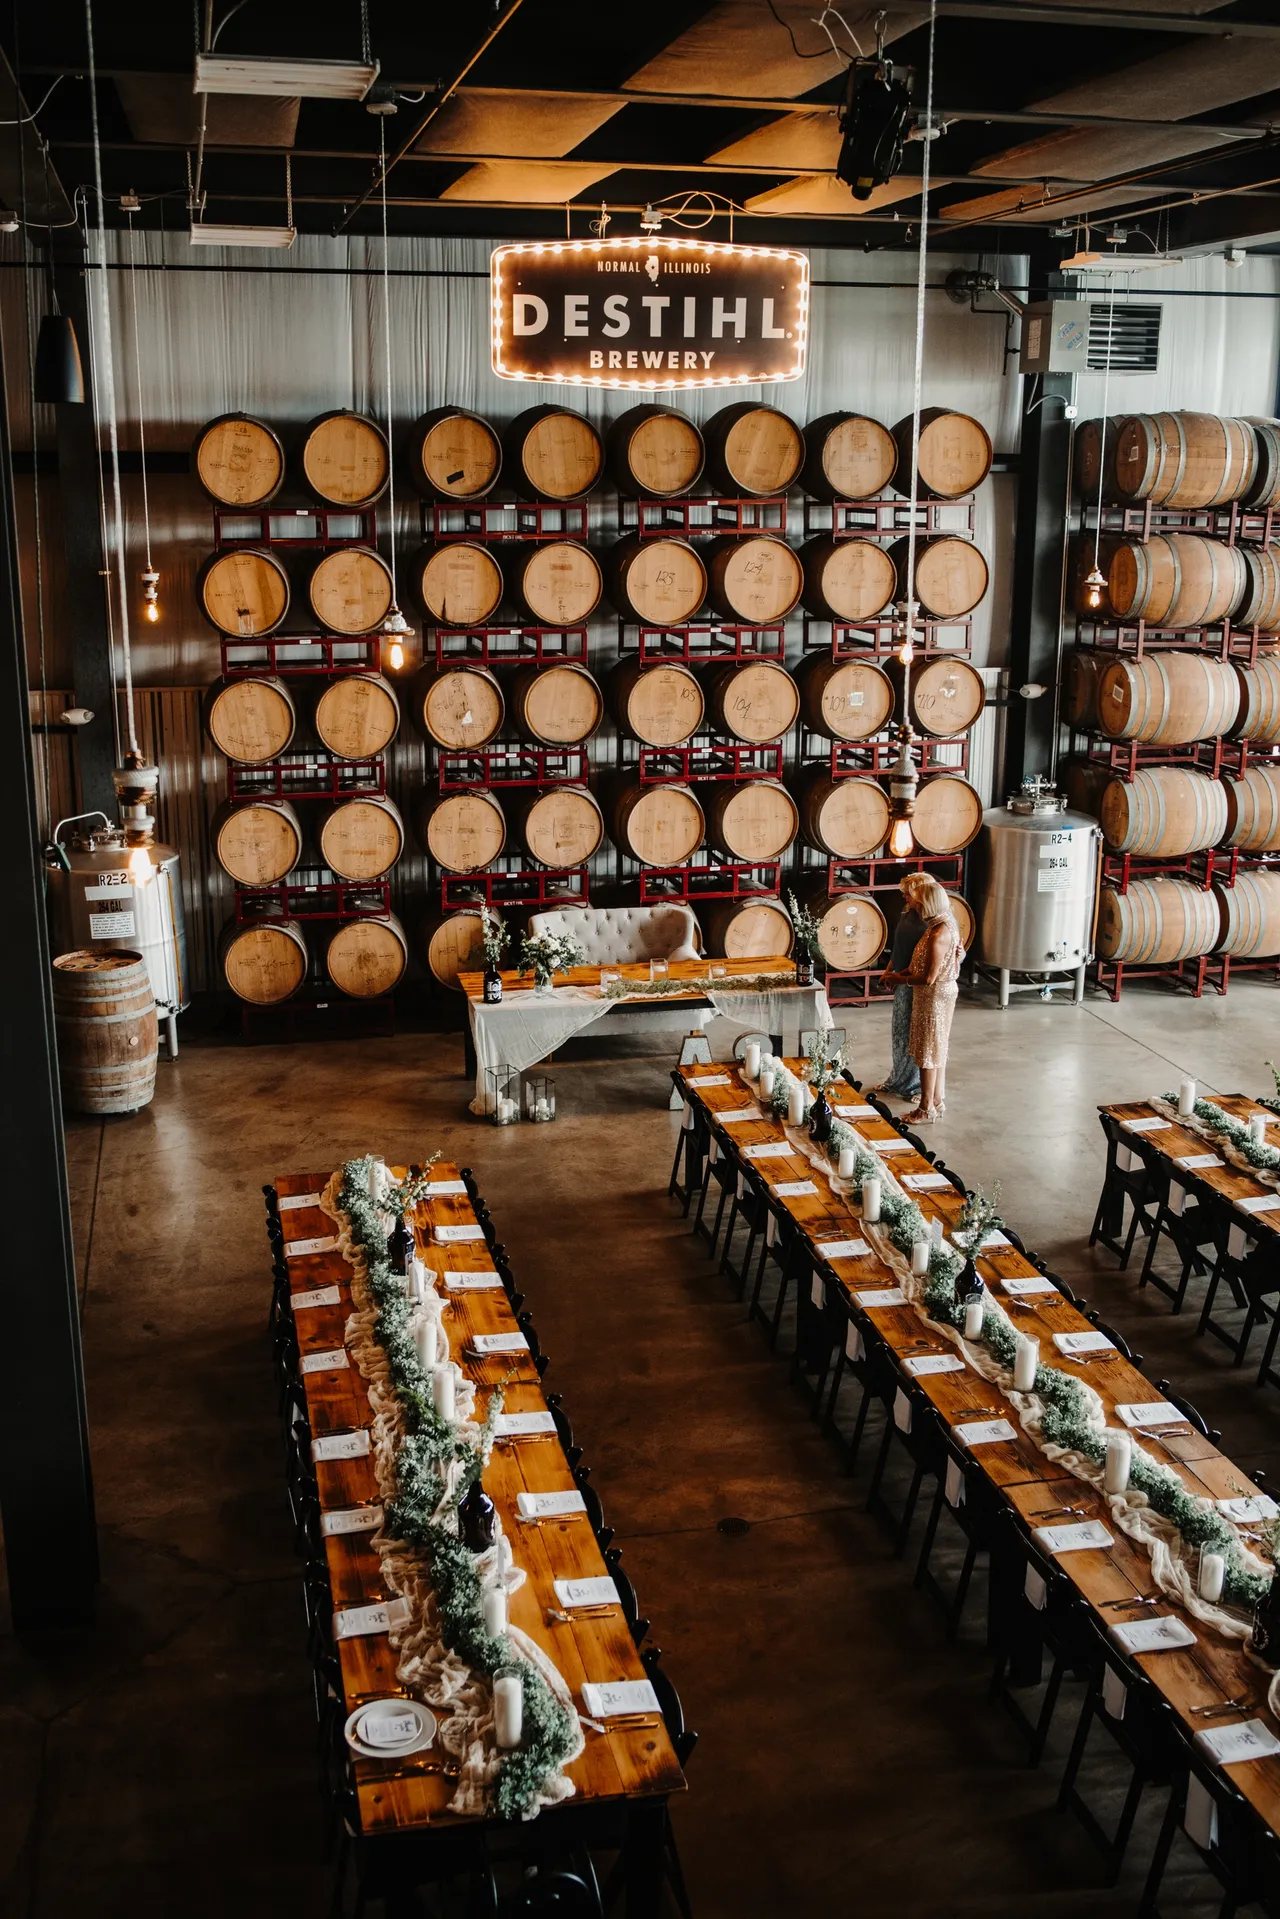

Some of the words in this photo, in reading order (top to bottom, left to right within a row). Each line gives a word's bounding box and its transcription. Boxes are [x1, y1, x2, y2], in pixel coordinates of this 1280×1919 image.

[597, 260, 641, 273] NORMAL
[663, 262, 712, 275] ILLINOIS
[512, 293, 786, 340] DESTIHL
[589, 349, 716, 370] BREWERY
[1051, 832, 1072, 844] R2-4
[110, 900, 123, 912] GAL
